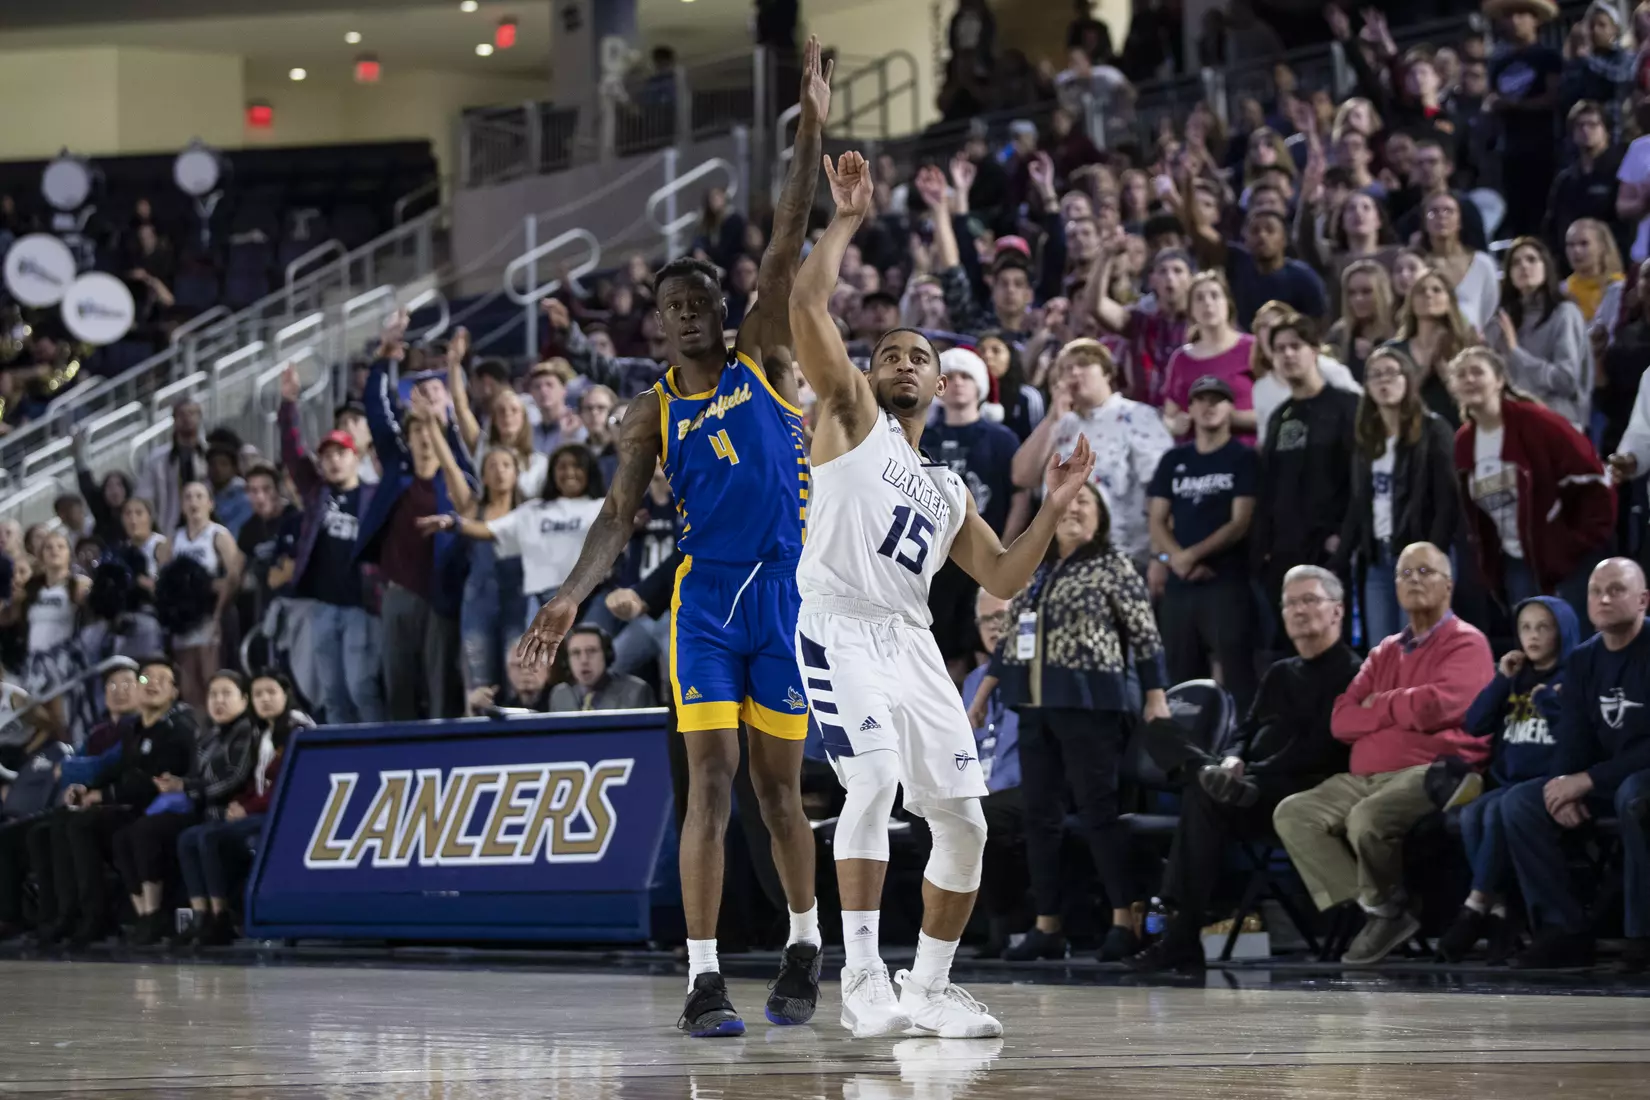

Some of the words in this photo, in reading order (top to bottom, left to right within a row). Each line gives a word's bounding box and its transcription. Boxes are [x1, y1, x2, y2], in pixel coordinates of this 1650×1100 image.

[707, 428, 740, 466] 4
[877, 505, 935, 575] 15
[304, 758, 635, 869] LANCERS
